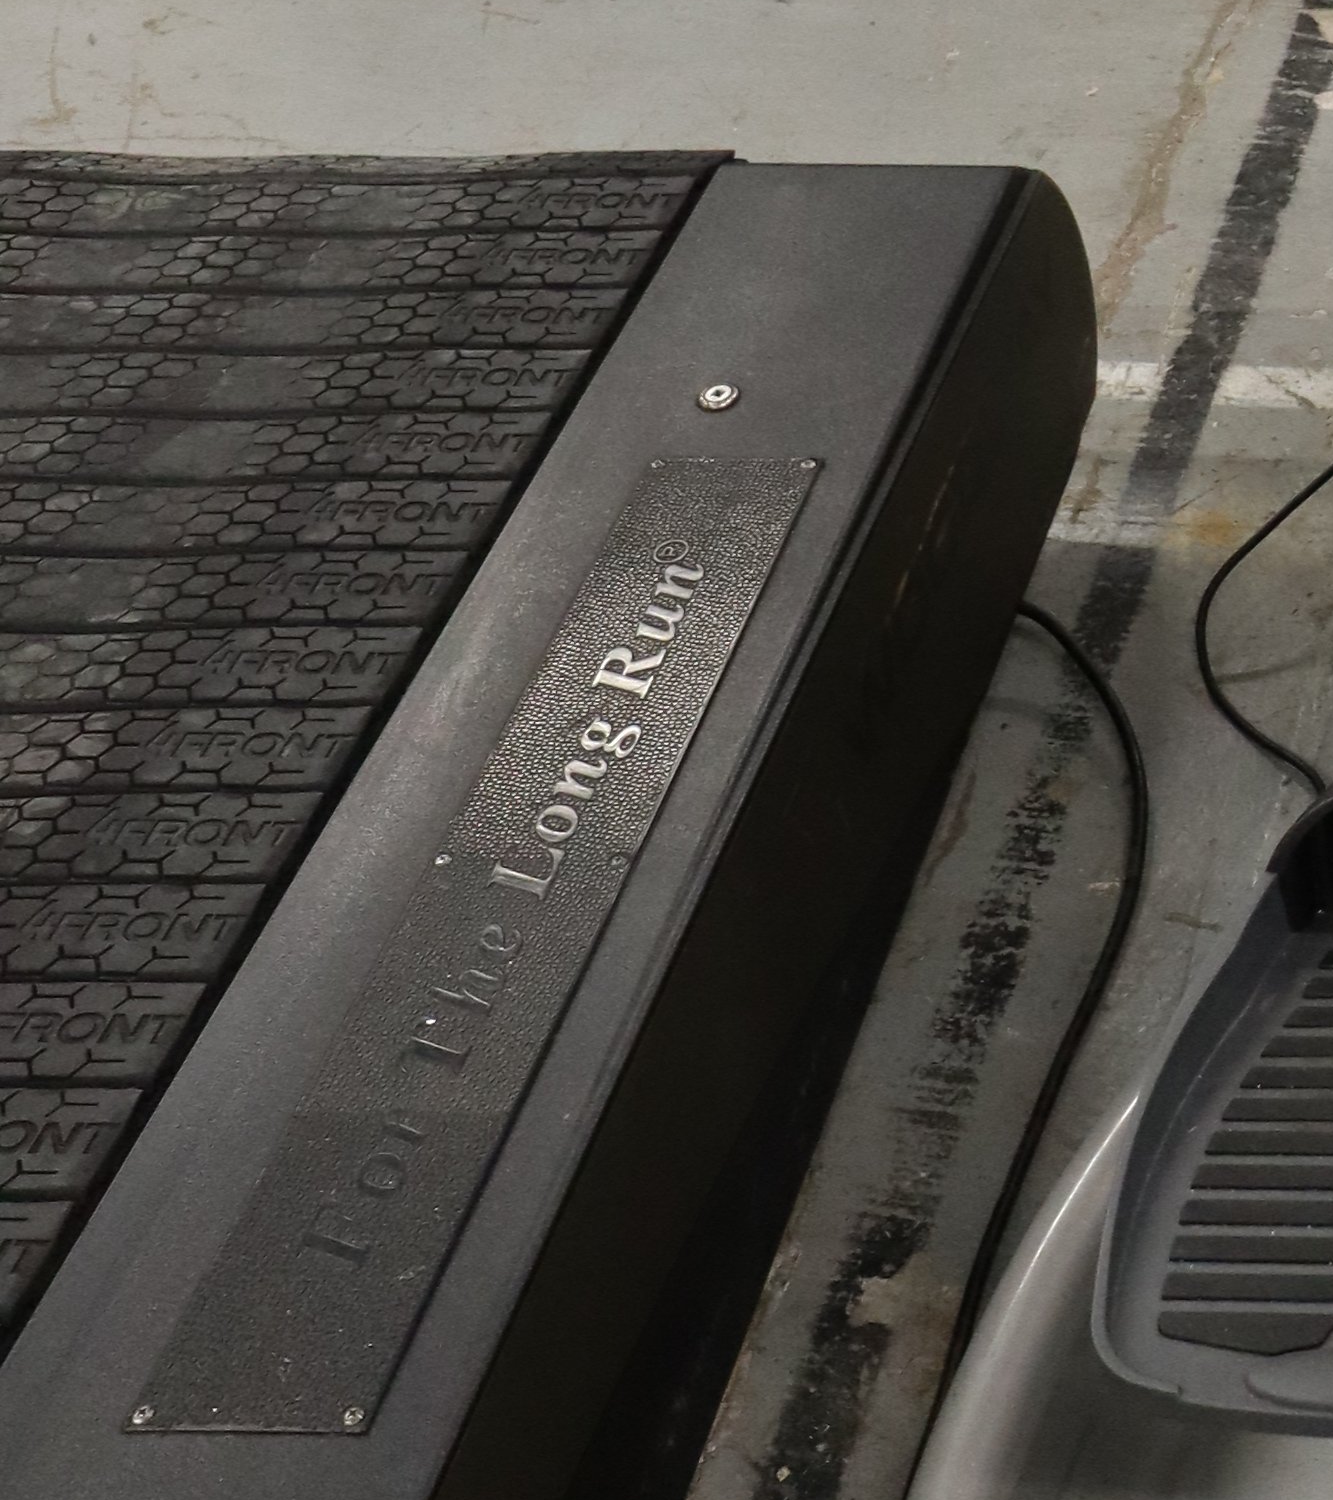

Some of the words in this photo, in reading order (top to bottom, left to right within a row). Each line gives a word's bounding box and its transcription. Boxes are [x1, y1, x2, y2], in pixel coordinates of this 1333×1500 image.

[303, 1114, 428, 1267] For
[407, 921, 525, 1076] The
[491, 718, 644, 902] Long
